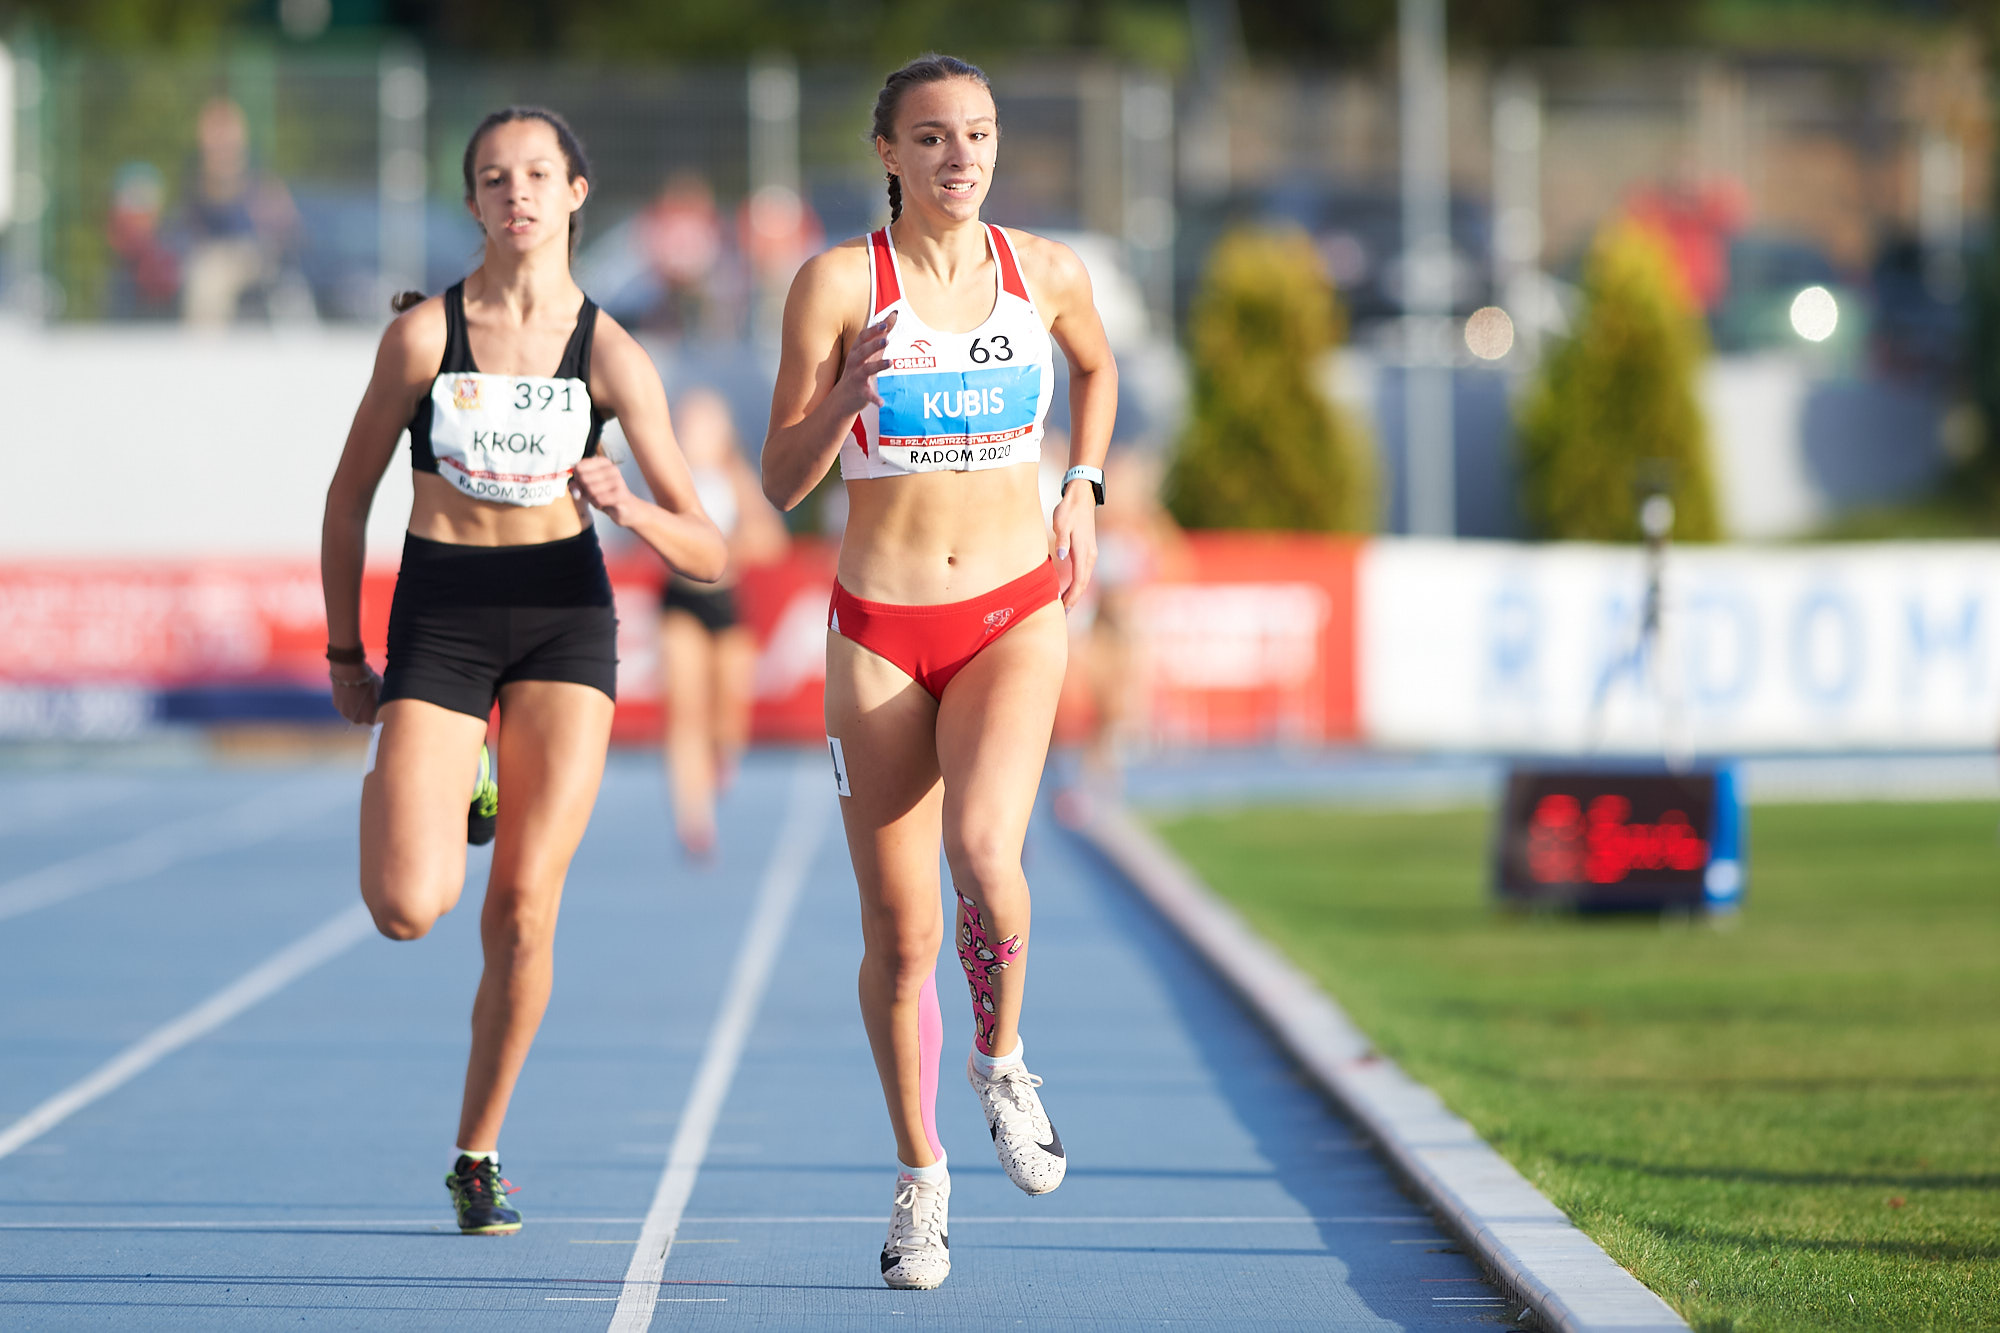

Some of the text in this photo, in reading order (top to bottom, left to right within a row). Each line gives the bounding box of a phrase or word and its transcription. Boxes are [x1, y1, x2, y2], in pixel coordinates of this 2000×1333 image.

[969, 335, 1013, 364] 63
[894, 357, 934, 369] ORLEN
[514, 382, 574, 412] 391
[923, 386, 1005, 419] KUBIS
[473, 430, 546, 455] KROK
[905, 438, 927, 446] PZLA
[910, 444, 1011, 464] RADOM 2020
[458, 474, 552, 499] RADOM 2020
